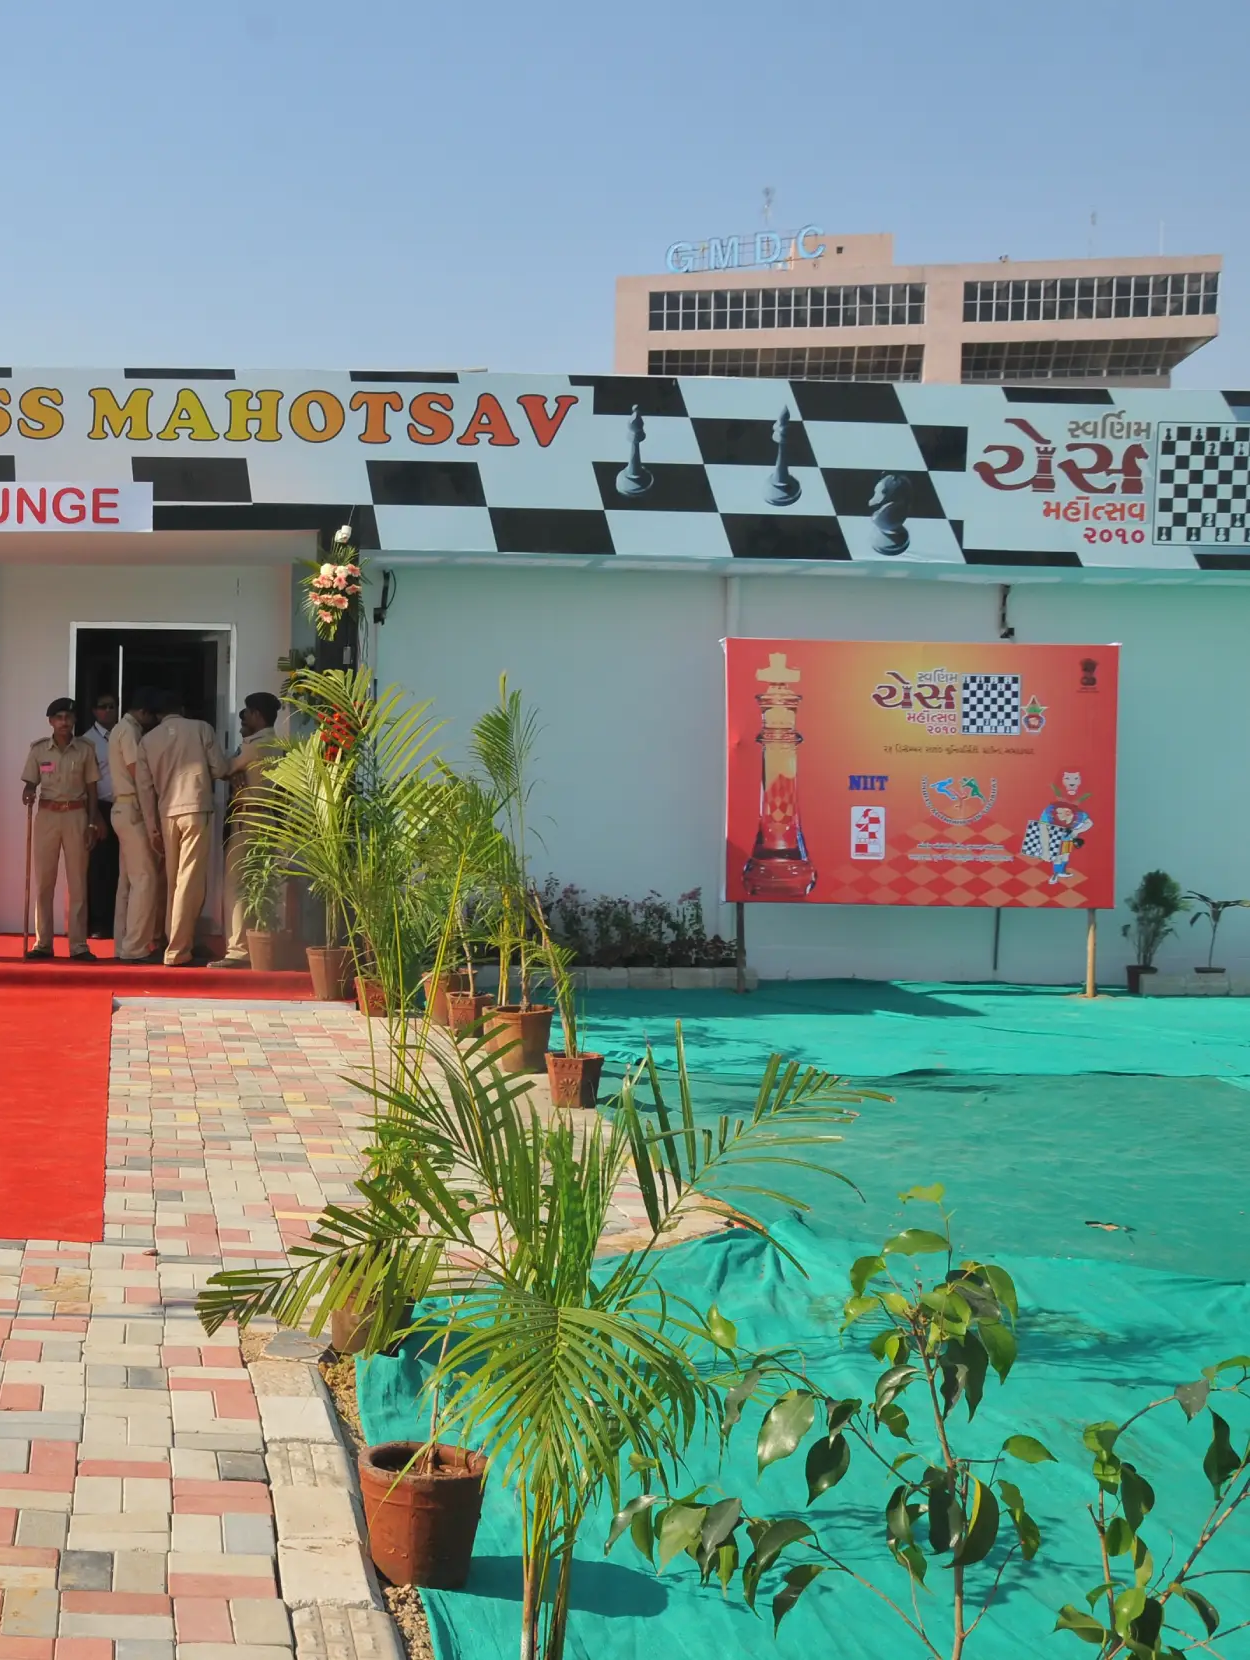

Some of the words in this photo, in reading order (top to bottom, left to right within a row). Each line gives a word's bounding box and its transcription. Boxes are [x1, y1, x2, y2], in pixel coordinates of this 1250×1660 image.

[666, 224, 826, 273] GMDC
[87, 387, 579, 448] MAHOTSAV
[1067, 410, 1152, 440] સ્વર્ણિમ
[1083, 527, 1146, 544] ૨૦૧૦
[926, 725, 957, 735] ૨૦૧૦
[848, 774, 889, 791] NIIT
